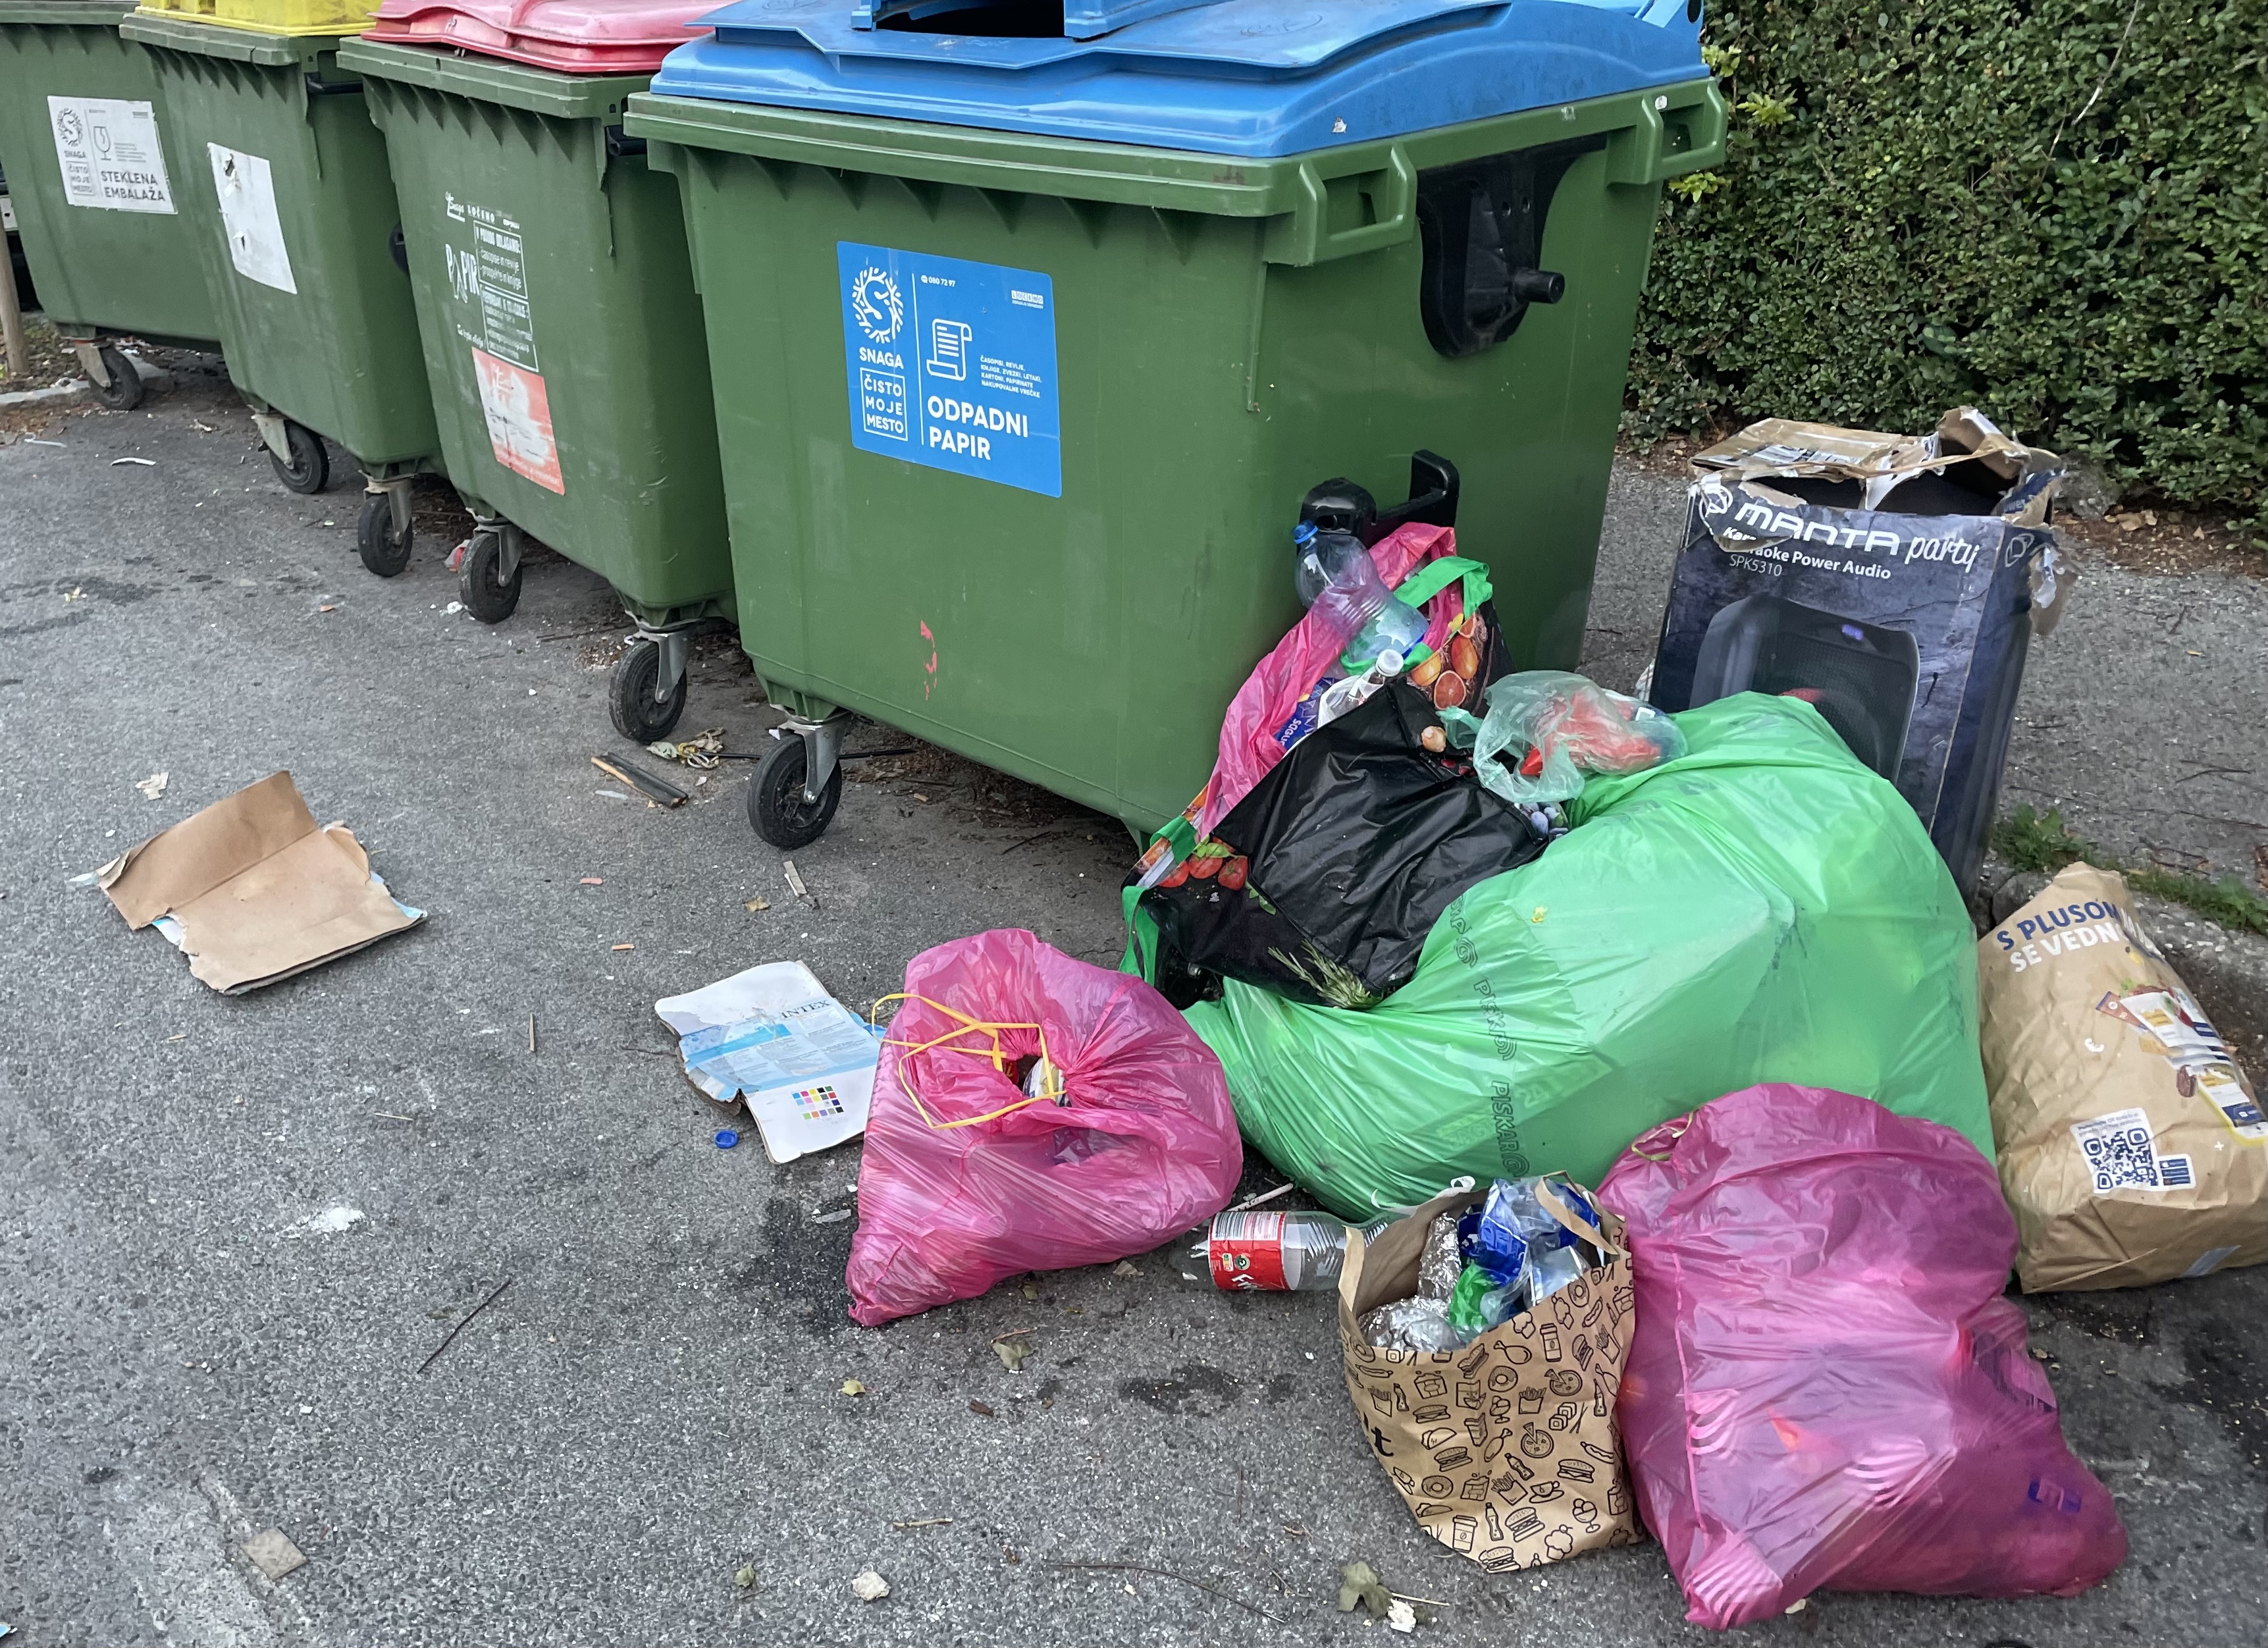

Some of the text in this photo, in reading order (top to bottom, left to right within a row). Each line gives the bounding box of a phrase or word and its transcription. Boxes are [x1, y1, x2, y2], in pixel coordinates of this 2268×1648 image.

[100, 170, 157, 185] STEKLENA
[105, 186, 165, 201] EMBALAŽA
[928, 276, 940, 285] 080
[940, 278, 948, 286] 72
[859, 346, 904, 369] SNAGA
[864, 373, 902, 397] ČISTO
[865, 396, 903, 415] MOJE
[928, 395, 1028, 438] ODPADNI
[866, 413, 904, 433] MESTO
[929, 426, 991, 460] PAPIR
[1734, 502, 1980, 573] MANTA party
[1729, 554, 1783, 577] SPK5310
[1791, 550, 1841, 571] Power
[1843, 560, 1891, 579] Audio
[1997, 930, 2015, 951] S
[2010, 944, 2042, 972] SE
[779, 999, 831, 1019] INTEX
